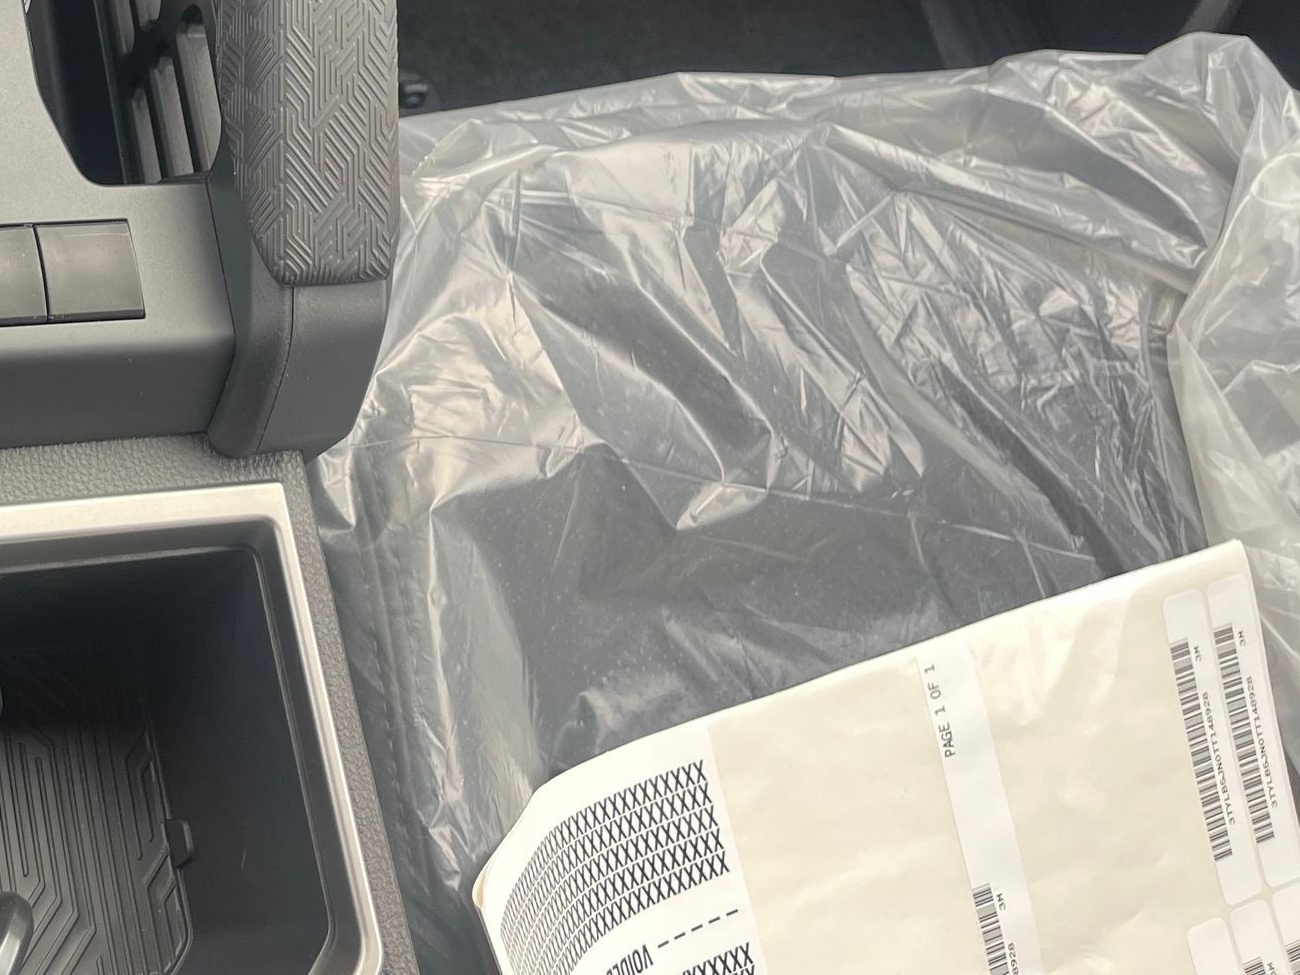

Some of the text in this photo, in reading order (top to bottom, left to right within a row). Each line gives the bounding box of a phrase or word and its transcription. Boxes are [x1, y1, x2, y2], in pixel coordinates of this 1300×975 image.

[923, 663, 956, 758] PAGE 1 OF 1
